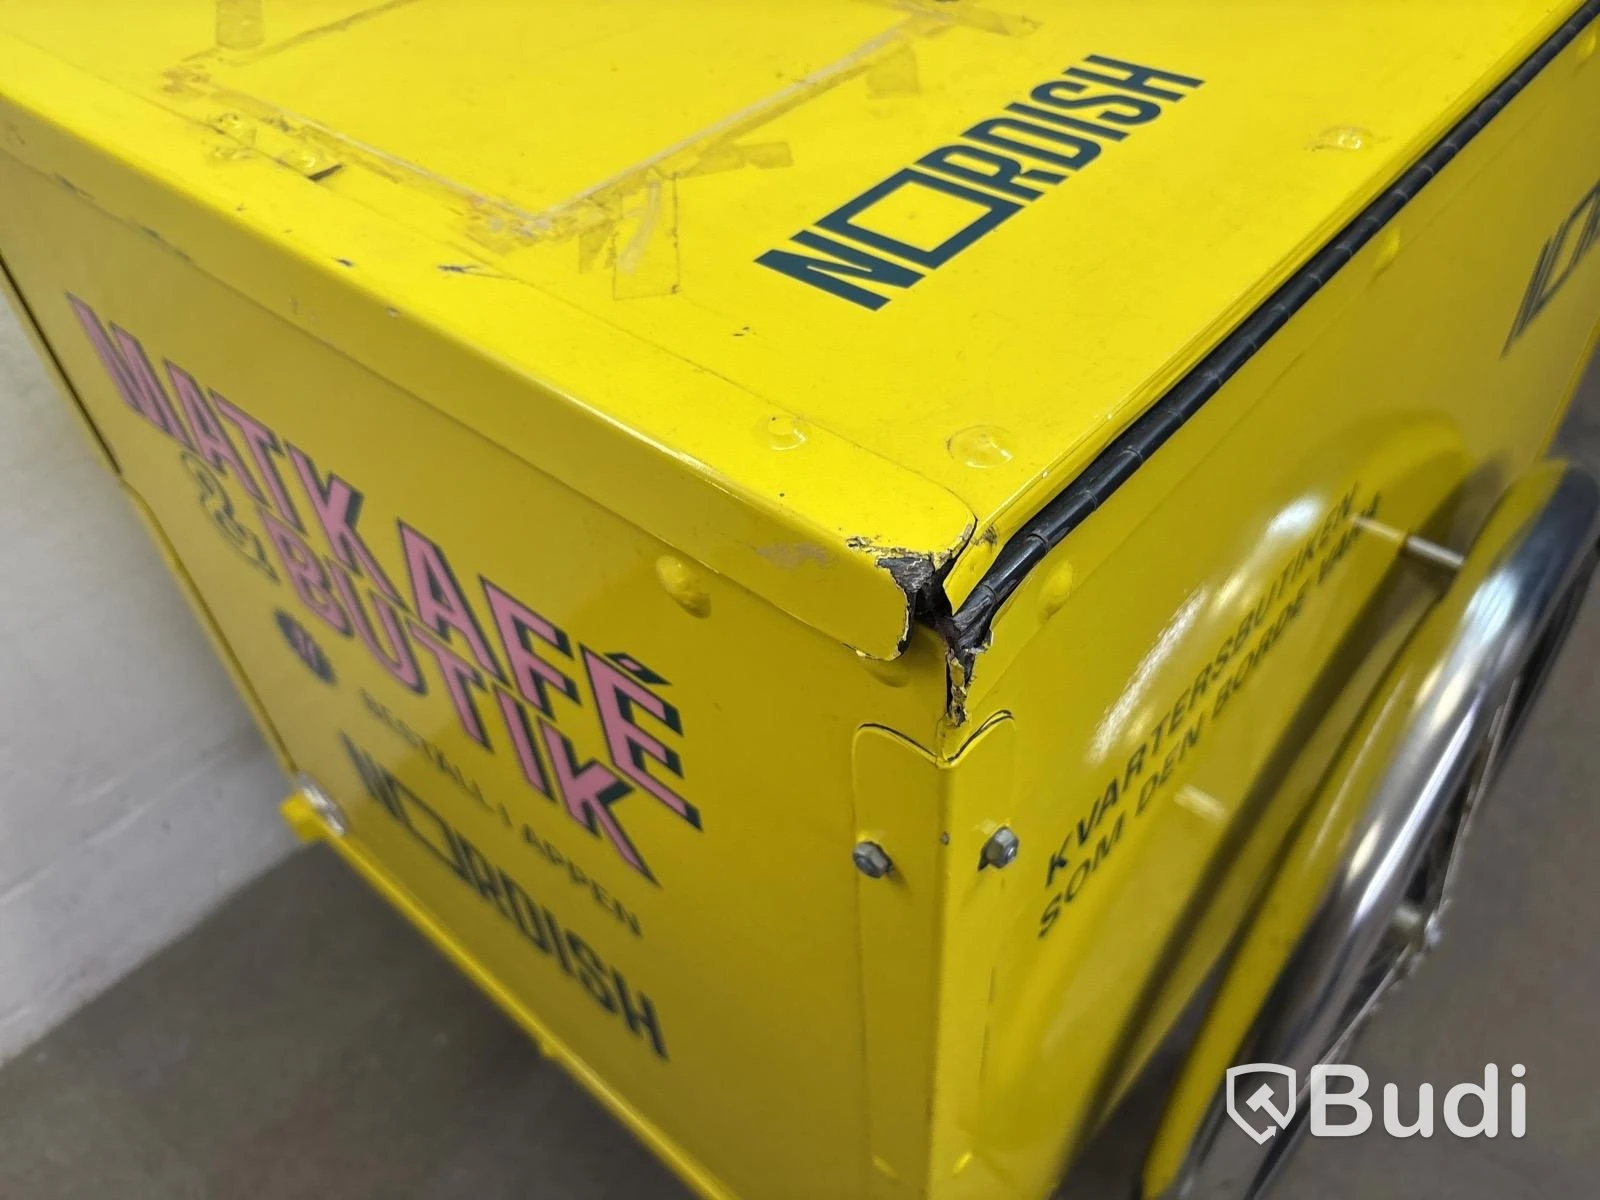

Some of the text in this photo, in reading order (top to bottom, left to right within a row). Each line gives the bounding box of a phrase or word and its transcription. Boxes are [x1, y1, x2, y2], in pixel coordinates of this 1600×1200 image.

[754, 54, 1206, 311] NORDISH
[65, 289, 704, 833] MATKAFÉ
[256, 504, 662, 888] BUTIK
[1045, 480, 1358, 888] KVARTERSBUTIKEN
[339, 731, 668, 1063] NORDISH
[521, 822, 643, 938] APPEN
[1038, 812, 1126, 938] SOM
[1135, 711, 1204, 818] DEN
